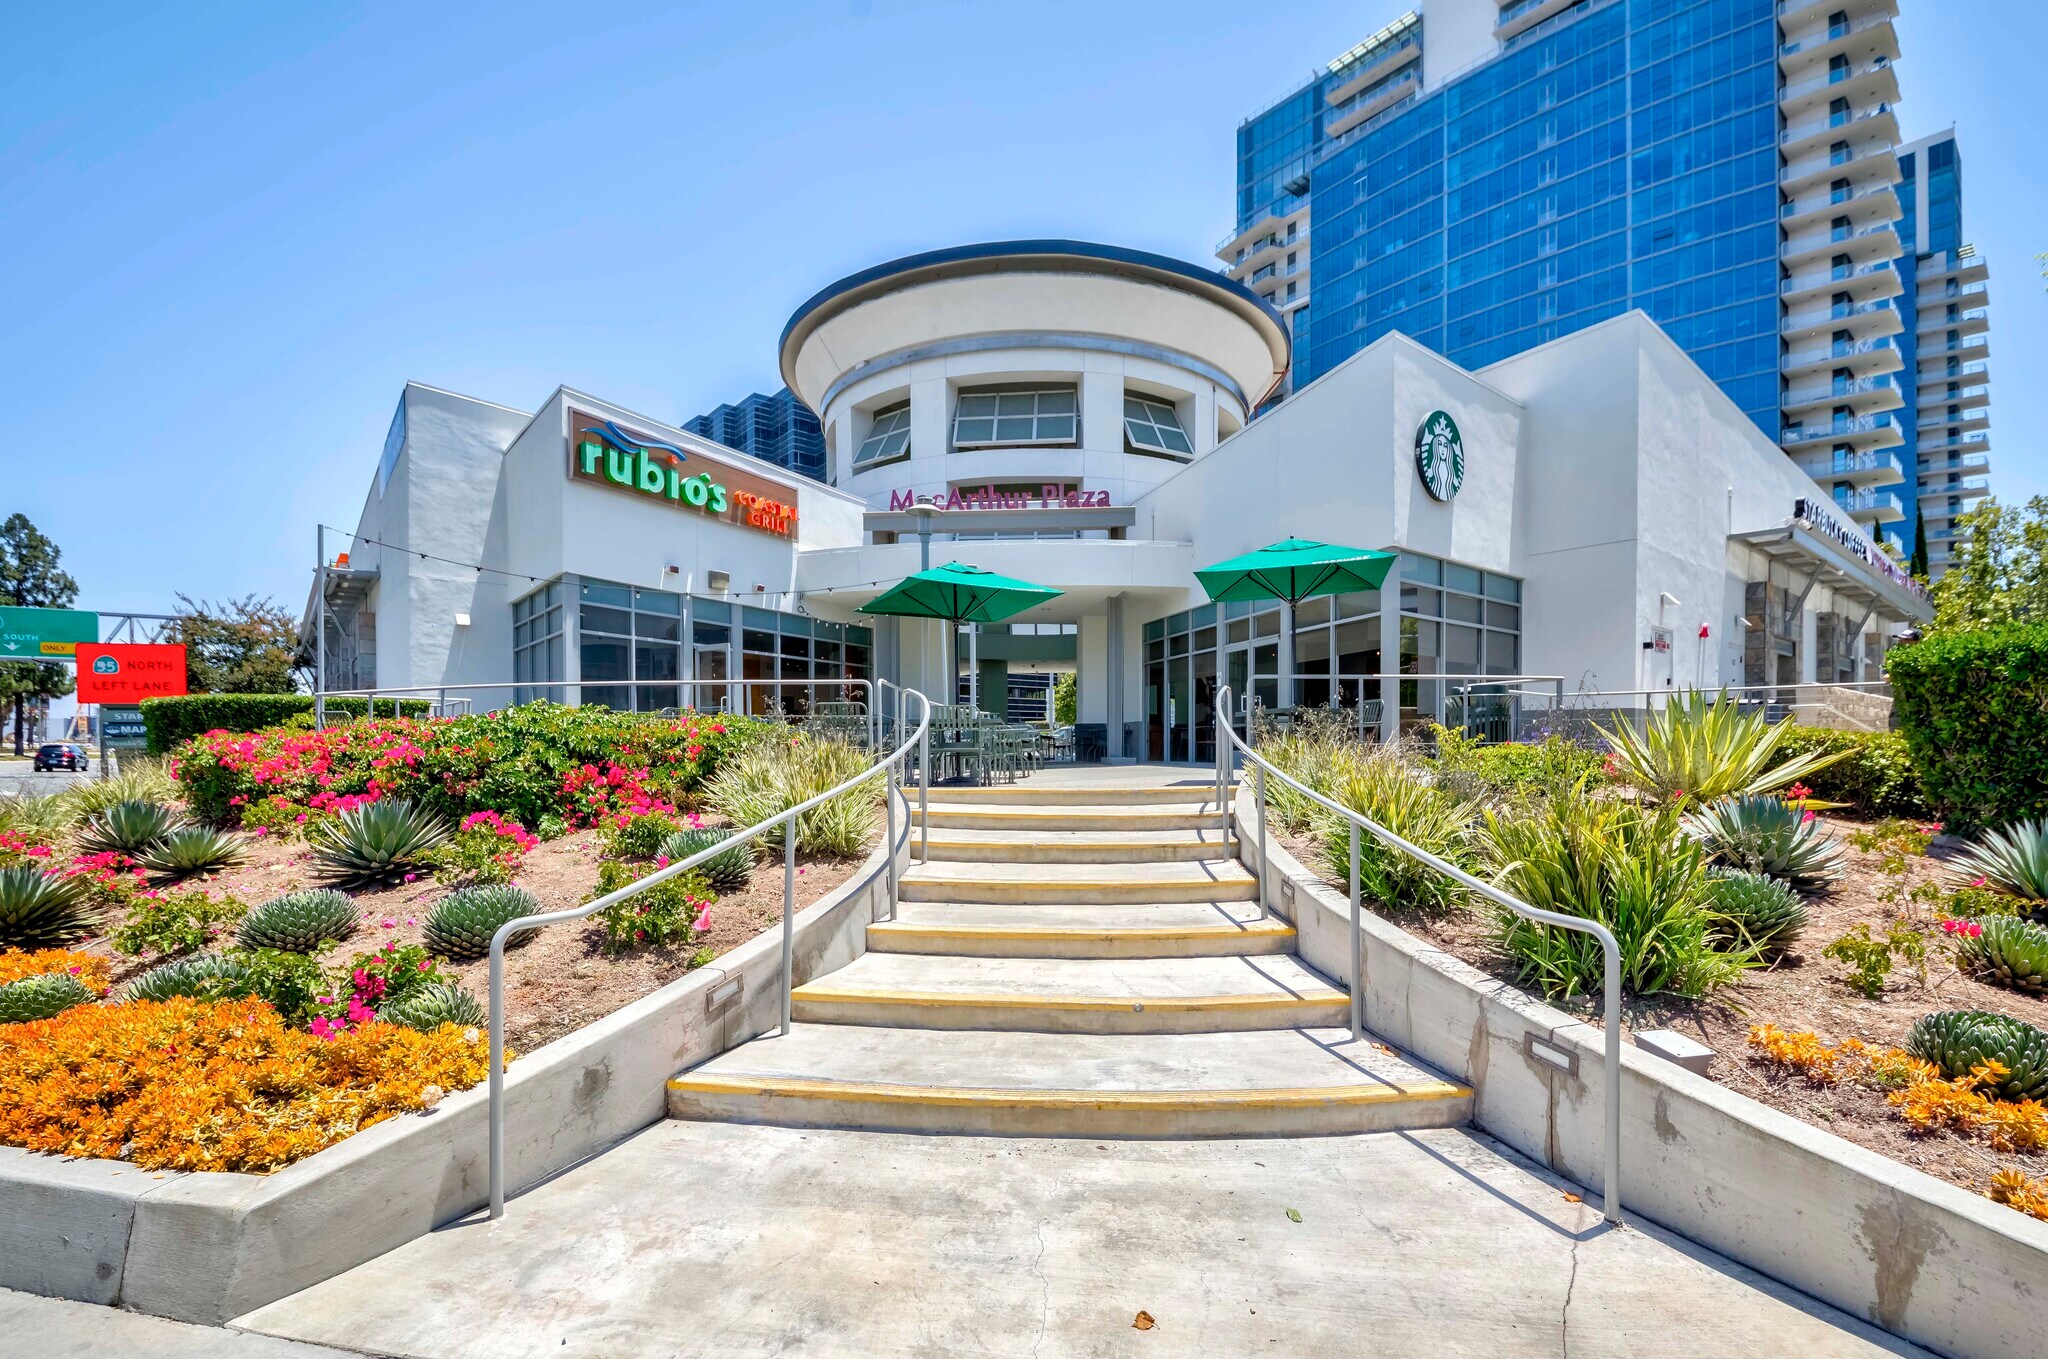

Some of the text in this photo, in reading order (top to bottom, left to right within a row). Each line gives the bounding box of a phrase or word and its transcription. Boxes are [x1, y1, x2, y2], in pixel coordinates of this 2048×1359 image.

[579, 440, 728, 513] rubio's
[734, 490, 800, 520] COASTAL
[889, 481, 1111, 511] McArthur Plaza
[746, 511, 789, 534] GRILL
[3, 633, 39, 641] SOUTH
[127, 661, 173, 671] NORTH
[92, 680, 171, 691] LEFT LANE
